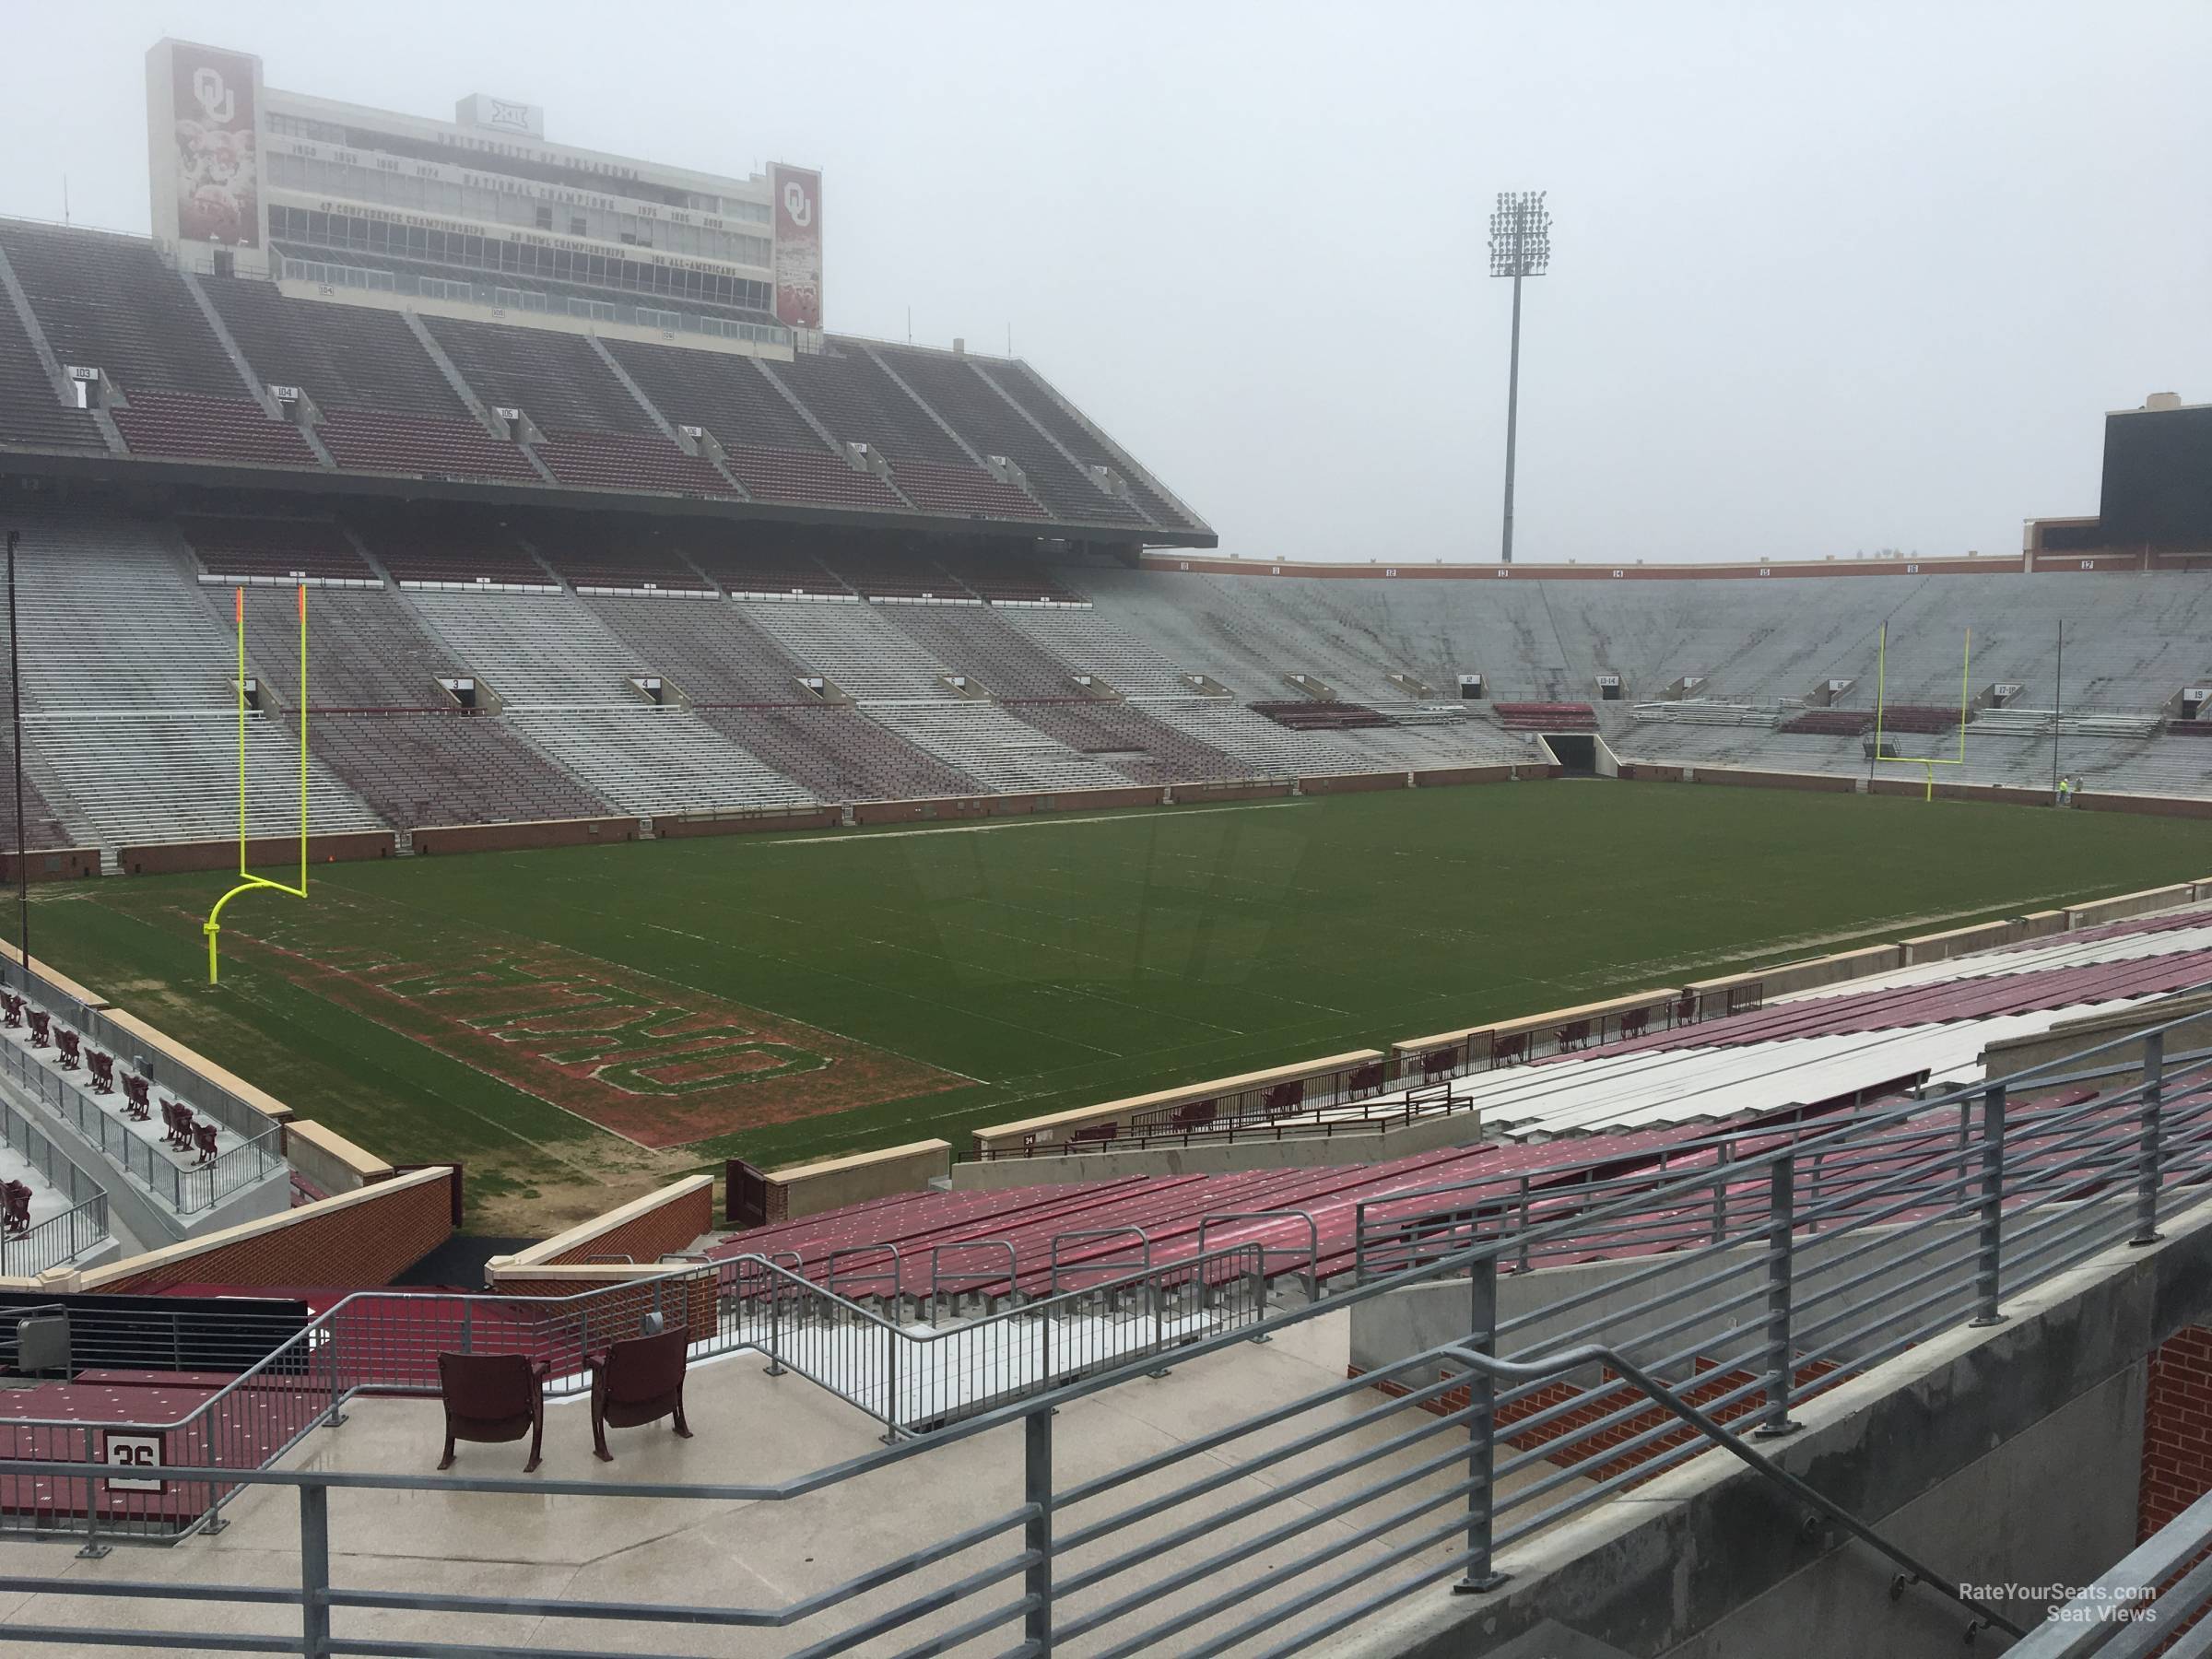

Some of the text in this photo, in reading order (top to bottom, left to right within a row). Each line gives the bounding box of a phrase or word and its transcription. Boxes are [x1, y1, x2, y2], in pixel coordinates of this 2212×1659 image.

[194, 67, 234, 123] OU
[438, 132, 639, 182] UNIVERSITY OF OKLAHOMA
[416, 165, 439, 179] 1974
[464, 173, 533, 197] NATIONAL
[540, 187, 615, 210] CHAMPIONS
[784, 182, 811, 227] OU
[336, 205, 403, 224] CONFERENCE
[406, 215, 486, 237] CHAMPIONSHIPS
[526, 233, 551, 247] BOWL
[554, 238, 626, 259] CHAMPIONSHIPS
[669, 256, 736, 276] ALL-AMERICANS
[76, 368, 90, 378] 103
[278, 387, 292, 396] 104
[501, 408, 513, 418] 105
[1909, 565, 1917, 573] 16
[2084, 560, 2092, 569] 17
[1388, 569, 1394, 577] 12
[1500, 569, 1507, 577] 13
[453, 679, 459, 689] 3
[641, 678, 649, 688] 4
[806, 677, 812, 687] 5
[2194, 690, 2204, 700] 19
[1025, 1135, 1034, 1146] 34
